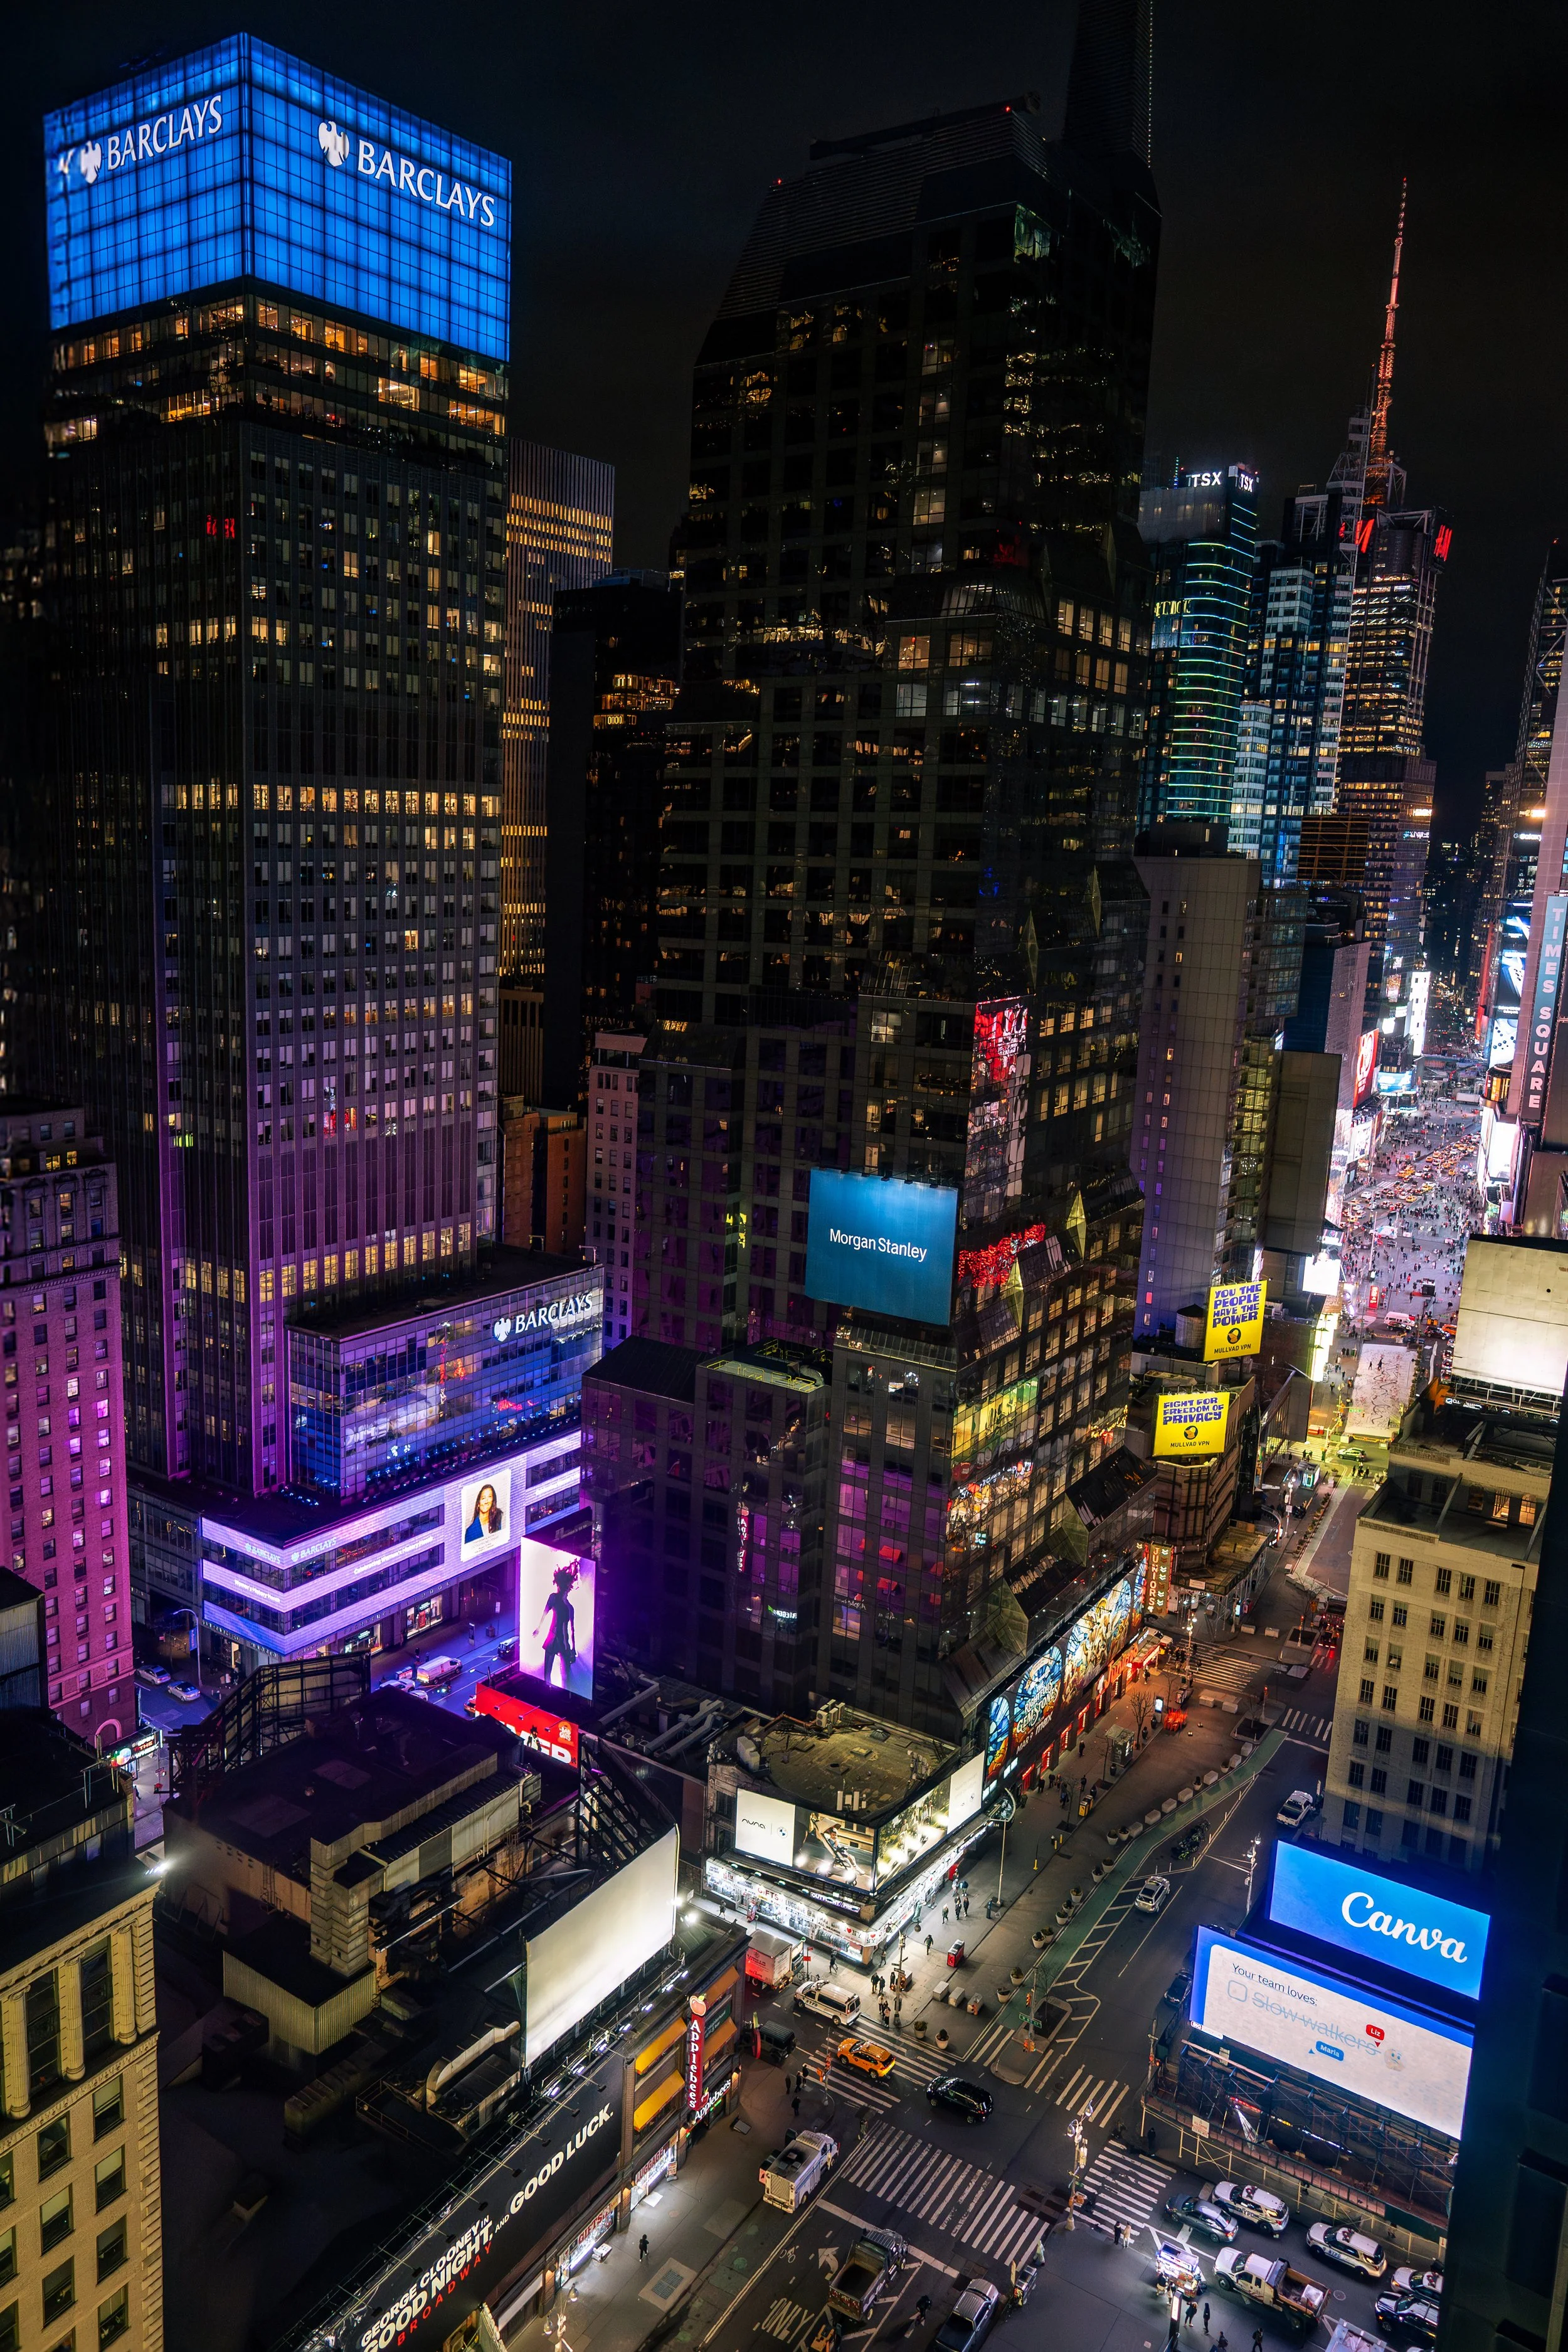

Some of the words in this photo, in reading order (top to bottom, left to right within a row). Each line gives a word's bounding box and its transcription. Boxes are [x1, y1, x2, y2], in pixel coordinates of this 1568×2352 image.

[108, 95, 222, 170] BARCLAYS
[358, 139, 495, 227] BARCLAYS
[1192, 471, 1222, 487] TSX
[1240, 474, 1254, 492] TSX
[1542, 908, 1564, 993] TIMES
[1528, 1006, 1551, 1109] SQUARE
[830, 1228, 876, 1251] Morgan
[878, 1237, 927, 1263] Stanley
[1215, 1288, 1236, 1299] YOU
[1239, 1284, 1261, 1294] THE
[1213, 1306, 1237, 1318] HAVE
[1241, 1303, 1259, 1312] THE
[1214, 1293, 1259, 1310] PEOPLE
[515, 1293, 593, 1334] BARCLAYS
[1212, 1311, 1258, 1328] POWER
[1214, 1345, 1239, 1354] MULLVAD
[1163, 1400, 1194, 1409] FIGHT
[1163, 1405, 1210, 1416] FREEDOM
[1163, 1411, 1222, 1425] PRIVACY
[252, 1547, 281, 1564] BARCLAYS
[300, 1537, 337, 1559] BARCLAYS
[1024, 1680, 1053, 1713] RIGHTEOUS
[1017, 1684, 1059, 1734] GEMSTONES
[1016, 1736, 1029, 1754] MAR
[742, 1818, 766, 1830] nuna
[758, 1887, 779, 1900] GIFTS
[852, 1929, 862, 1939] NY
[1342, 1892, 1468, 1963] Canva
[1232, 1963, 1256, 1980] Your
[1258, 1974, 1285, 1992] team
[1288, 1985, 1318, 2006] loves:
[806, 1998, 818, 2007] NYPD
[1252, 1991, 1298, 2023] Slow
[1302, 2014, 1378, 2056] walkers
[1370, 2027, 1381, 2037] Liz
[1320, 2044, 1340, 2058] Maria
[694, 2079, 731, 2124] Applebee's
[636, 2147, 664, 2181] LUGGAGE
[431, 2220, 493, 2299] NIGHT,
[495, 2214, 510, 2233] AND
[510, 2151, 564, 2215] GOOD
[566, 2102, 614, 2161] LUCK.
[1238, 2208, 1255, 2219] NYPD
[578, 2215, 605, 2245] GIFTS
[1328, 2250, 1341, 2259] NYPD
[361, 2283, 417, 2348] GEORGE
[420, 2220, 480, 2288] CLOONEY
[480, 2215, 489, 2228] IN
[397, 2241, 492, 2346] BROADWAY
[761, 2297, 815, 2344] ONLY
